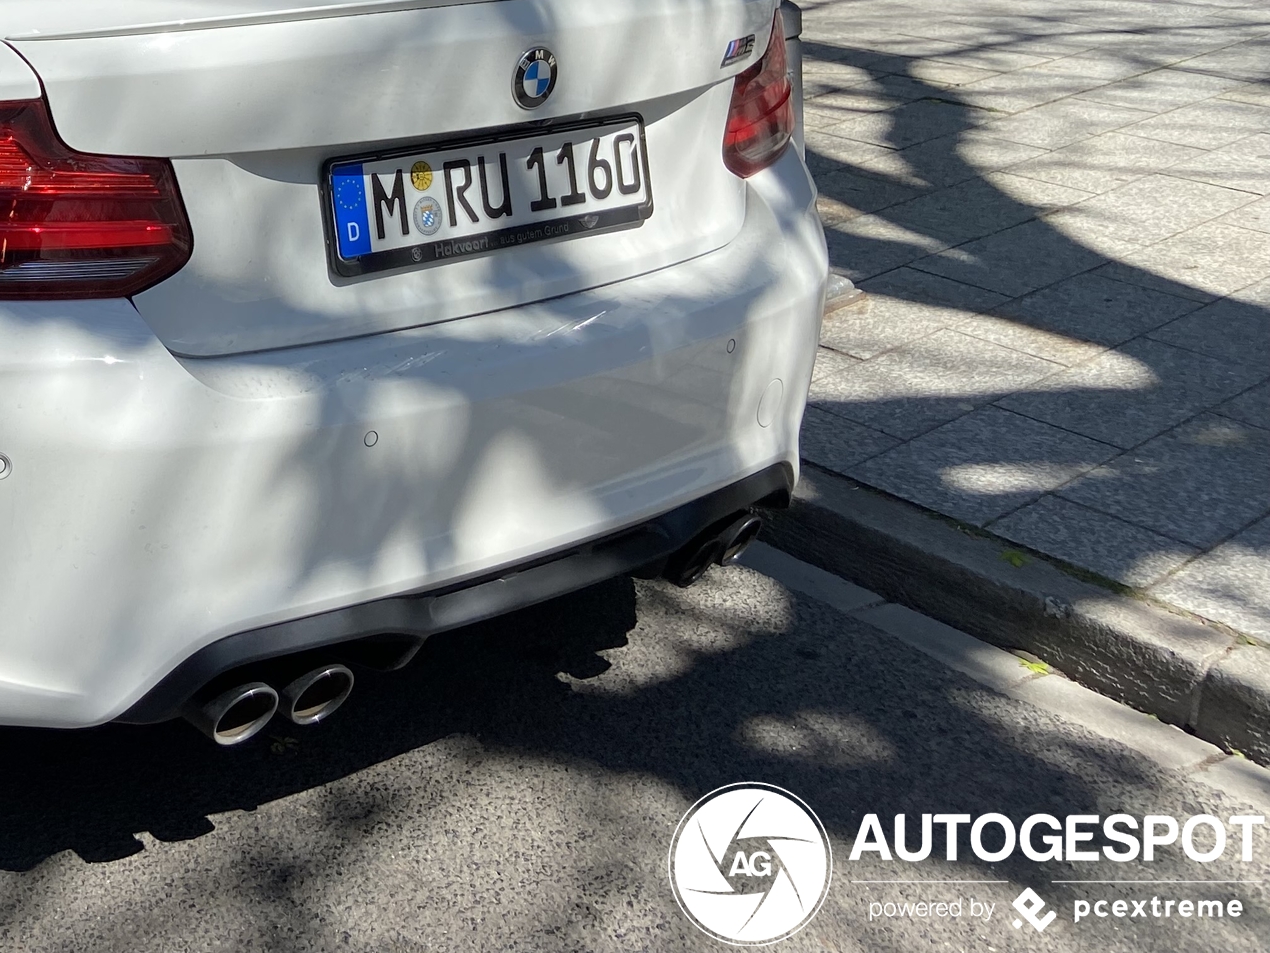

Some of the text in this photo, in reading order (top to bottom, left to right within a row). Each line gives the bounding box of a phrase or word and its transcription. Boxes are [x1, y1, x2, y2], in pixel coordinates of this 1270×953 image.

[520, 49, 557, 71] BMW
[371, 168, 410, 240] M
[442, 152, 512, 228] RU
[526, 132, 641, 213] 1160
[348, 222, 360, 242] D
[434, 236, 489, 258] Hakvoort
[516, 228, 543, 244] gutem
[544, 222, 570, 237] Grund
